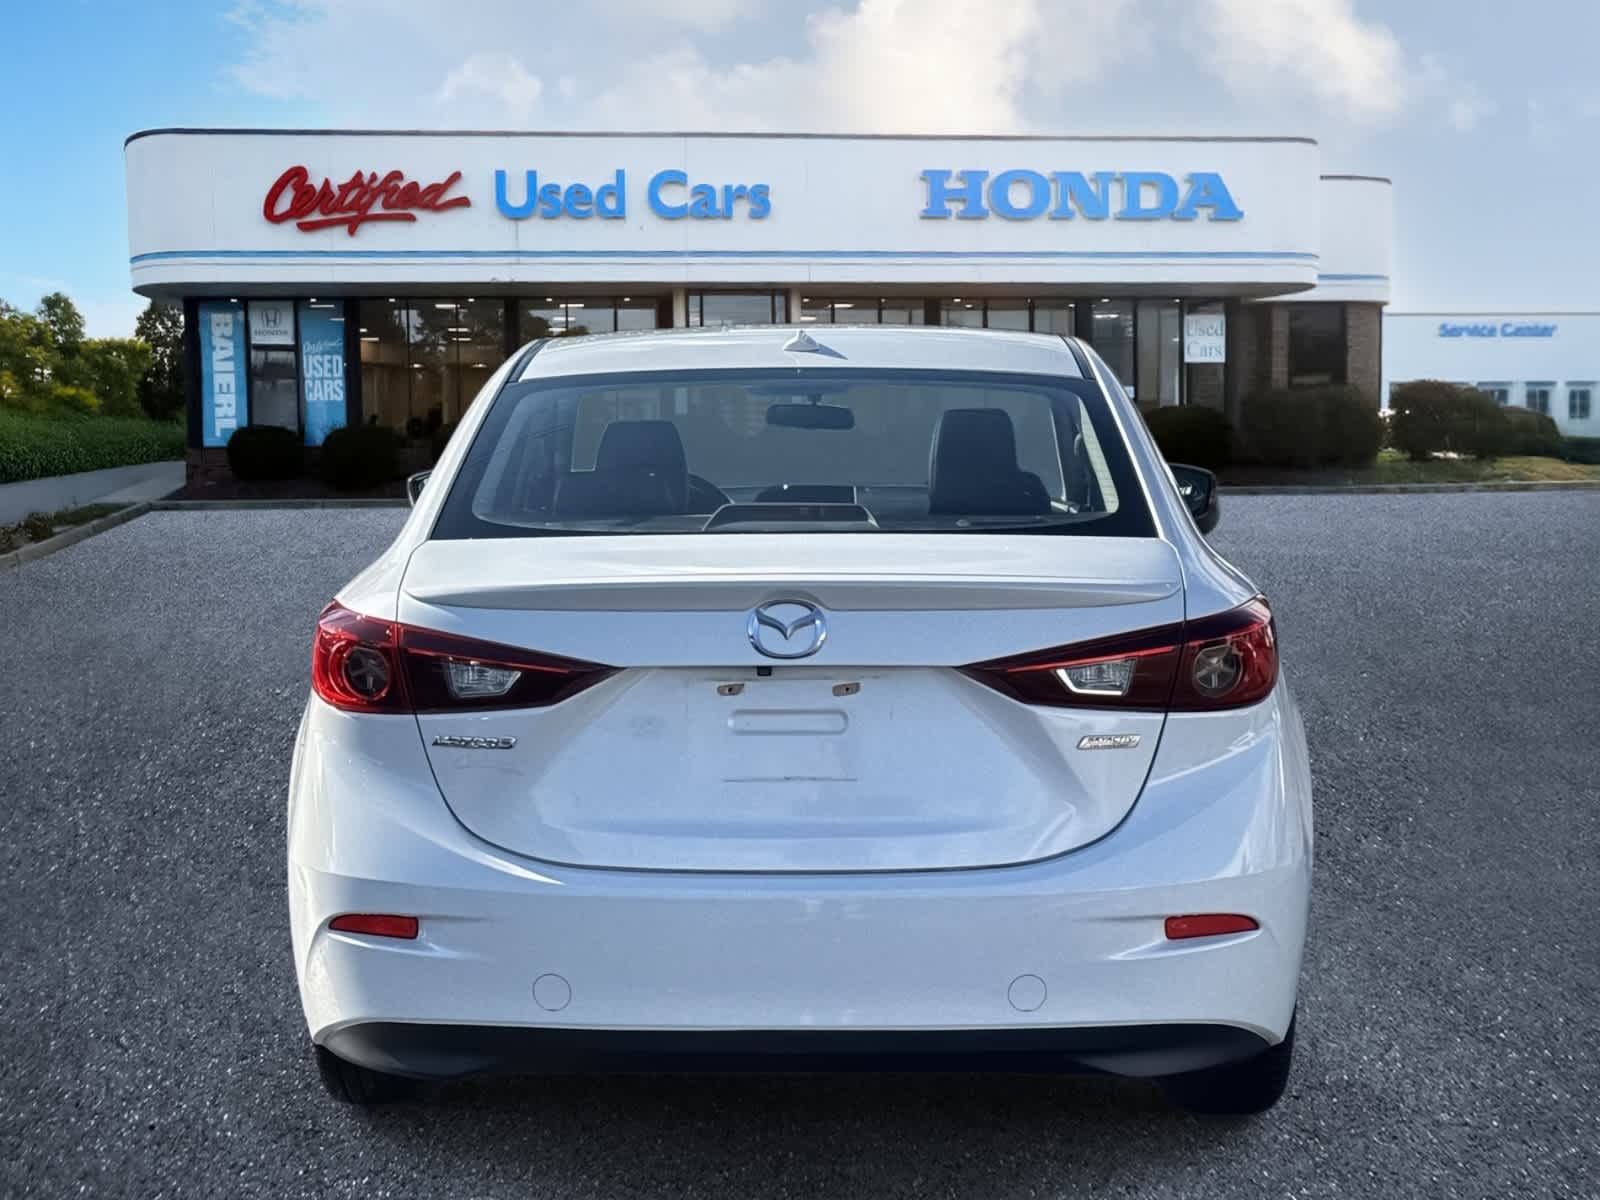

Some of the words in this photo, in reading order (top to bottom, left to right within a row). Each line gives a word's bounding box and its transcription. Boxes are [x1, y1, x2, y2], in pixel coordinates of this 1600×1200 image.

[264, 166, 471, 236] Certified
[495, 169, 625, 219] Used
[647, 169, 771, 219] Cars
[920, 169, 1244, 221] HONDA
[1186, 319, 1224, 336] Used
[1439, 323, 1497, 337] Service
[1501, 323, 1557, 337] Center
[1187, 342, 1222, 358] Cars
[211, 312, 237, 438] BAIERL
[303, 354, 342, 378] USED
[304, 379, 344, 401] CARS
